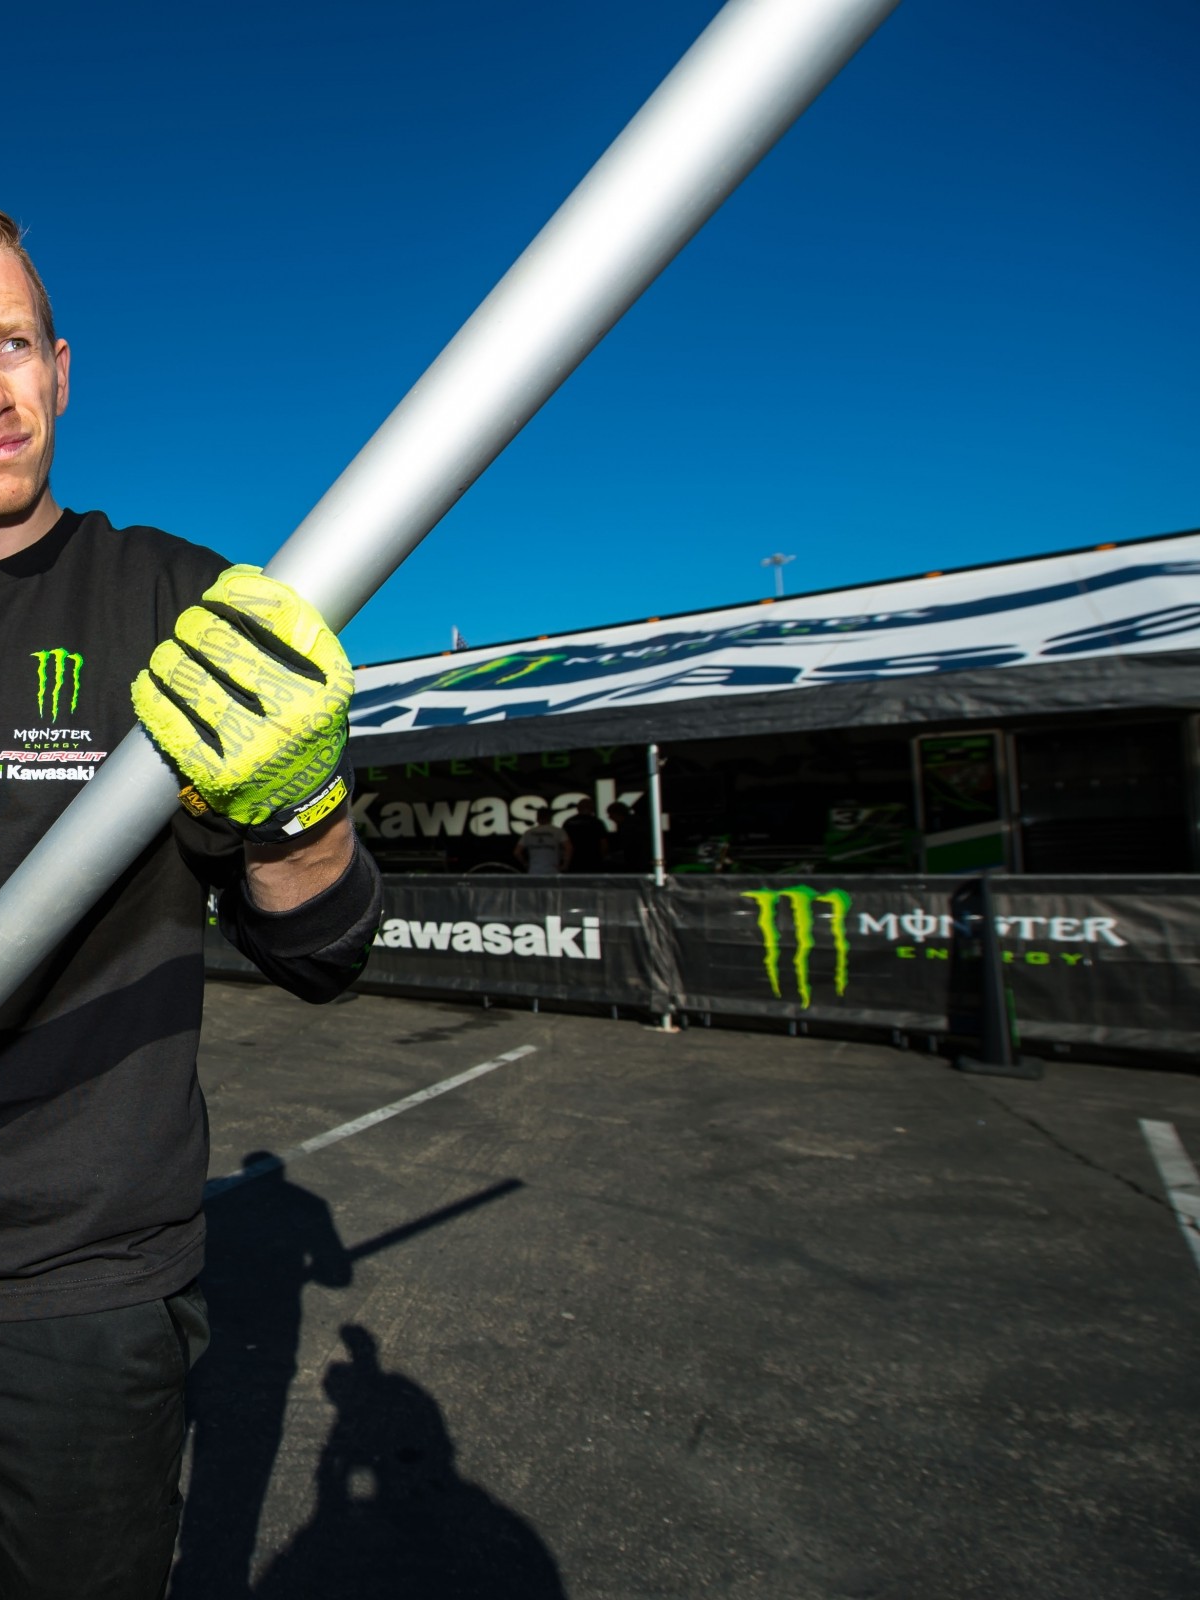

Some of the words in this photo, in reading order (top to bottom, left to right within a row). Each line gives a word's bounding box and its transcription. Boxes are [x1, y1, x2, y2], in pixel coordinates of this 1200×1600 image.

[13, 727, 92, 742] MONSTER
[37, 751, 107, 762] CIRCUIT
[7, 764, 95, 780] Kawasaki
[349, 778, 671, 840] Kawasak
